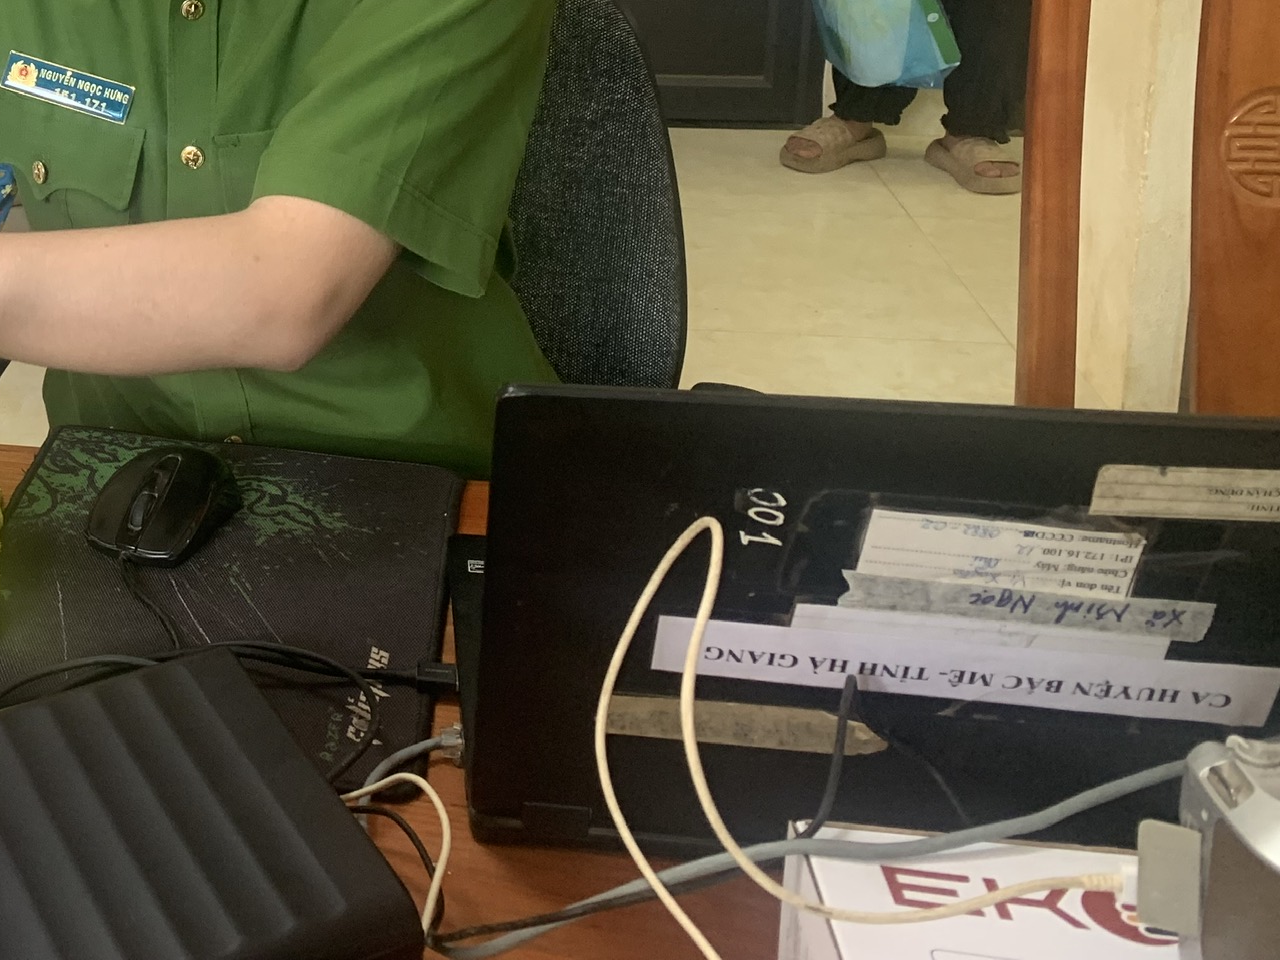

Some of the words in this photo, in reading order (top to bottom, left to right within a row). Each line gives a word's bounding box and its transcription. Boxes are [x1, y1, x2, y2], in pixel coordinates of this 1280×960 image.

[39, 68, 77, 87] NGUYỄN
[77, 80, 103, 97] NGỌC
[1034, 561, 1059, 572] Máy
[1101, 584, 1121, 593] Tên
[968, 589, 1035, 615] Ngọc
[1055, 601, 1130, 624] Minh
[704, 645, 799, 669] GIANG
[807, 655, 849, 675] HÀ
[1001, 675, 1064, 699] BẮC
[1071, 680, 1181, 704] HUYỆN
[1190, 691, 1232, 709] CA
